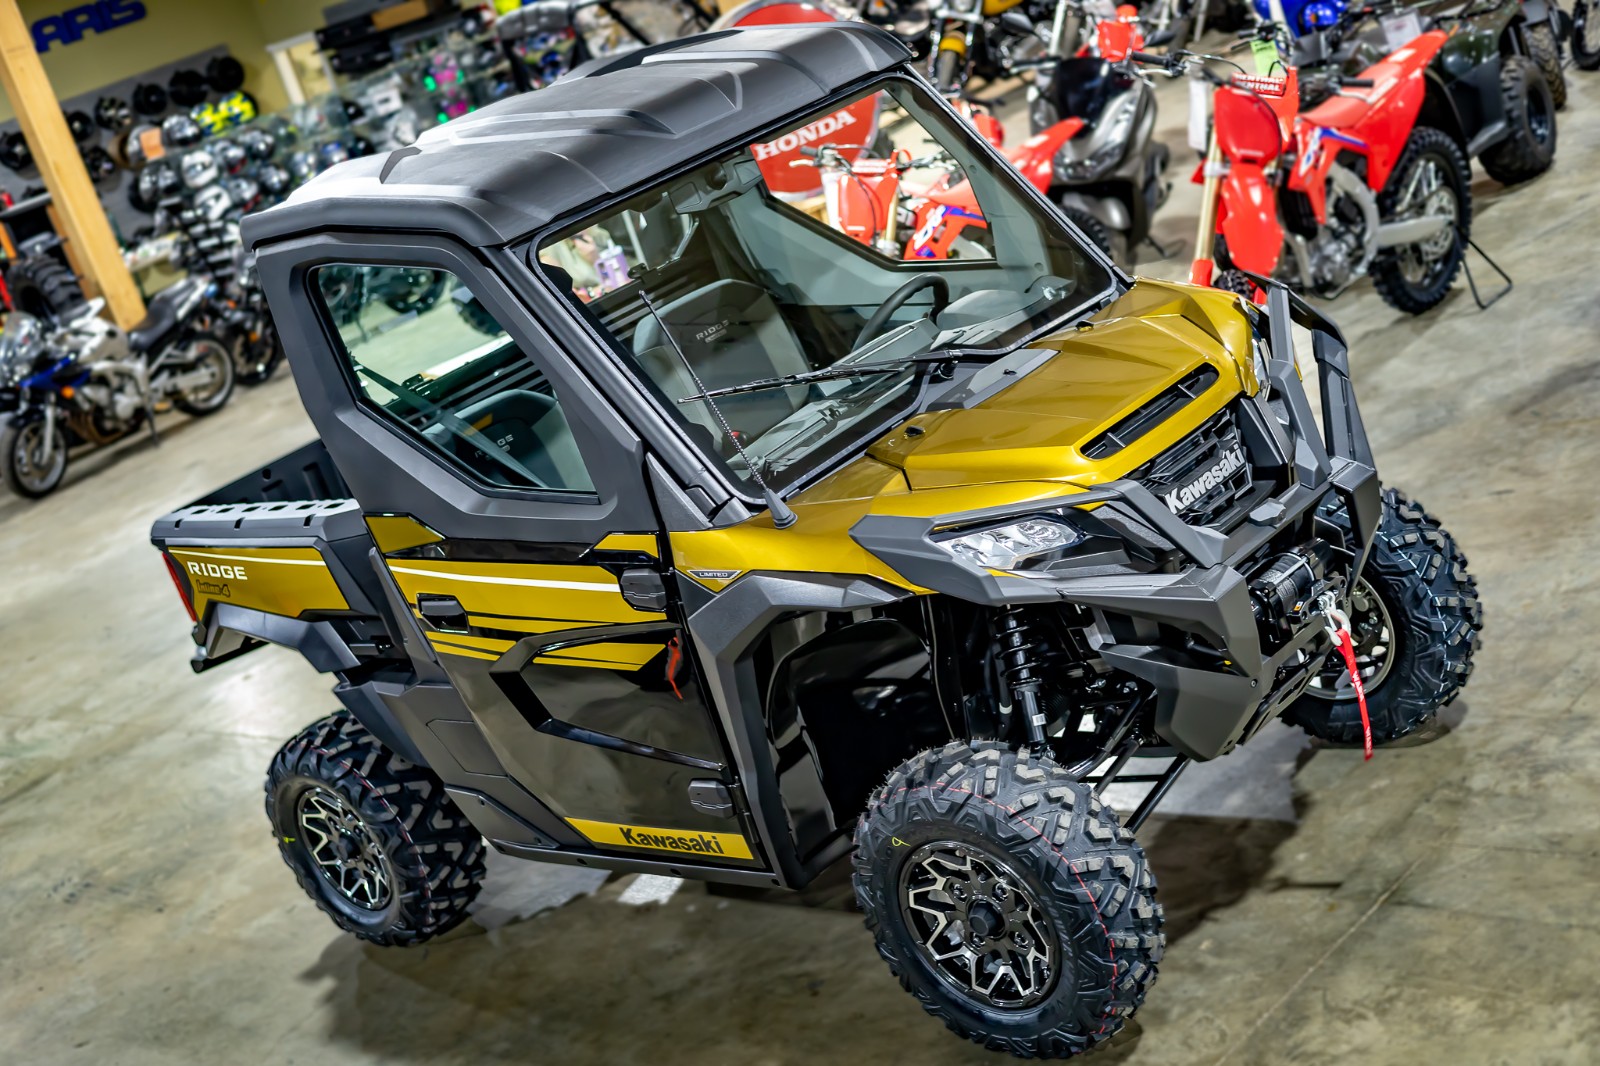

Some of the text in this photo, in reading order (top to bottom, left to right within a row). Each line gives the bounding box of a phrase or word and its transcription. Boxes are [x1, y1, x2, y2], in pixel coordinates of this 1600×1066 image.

[754, 110, 857, 160] HONDA
[475, 434, 514, 458] RGE
[1164, 443, 1245, 515] Kawasaki
[187, 561, 248, 580] RIDGE
[619, 826, 724, 854] Kawasaki
